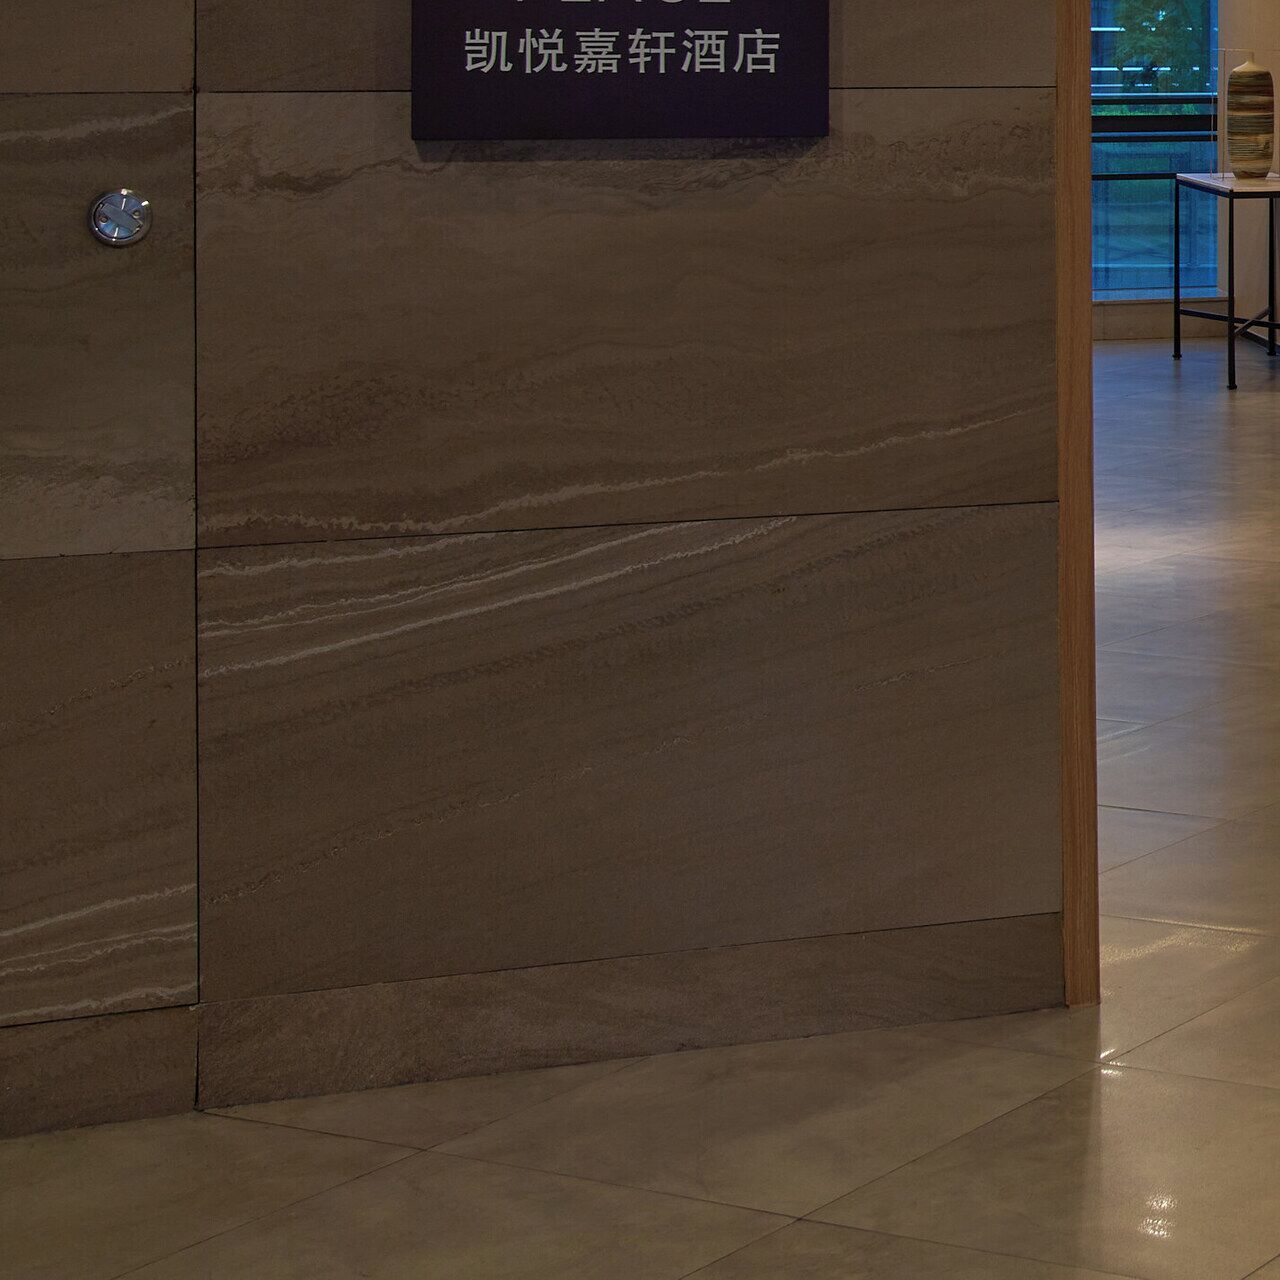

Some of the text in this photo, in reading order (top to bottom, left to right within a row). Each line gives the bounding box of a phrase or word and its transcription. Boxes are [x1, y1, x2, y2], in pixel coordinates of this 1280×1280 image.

[464, 28, 781, 74] 凯悦嘉轩酒店
